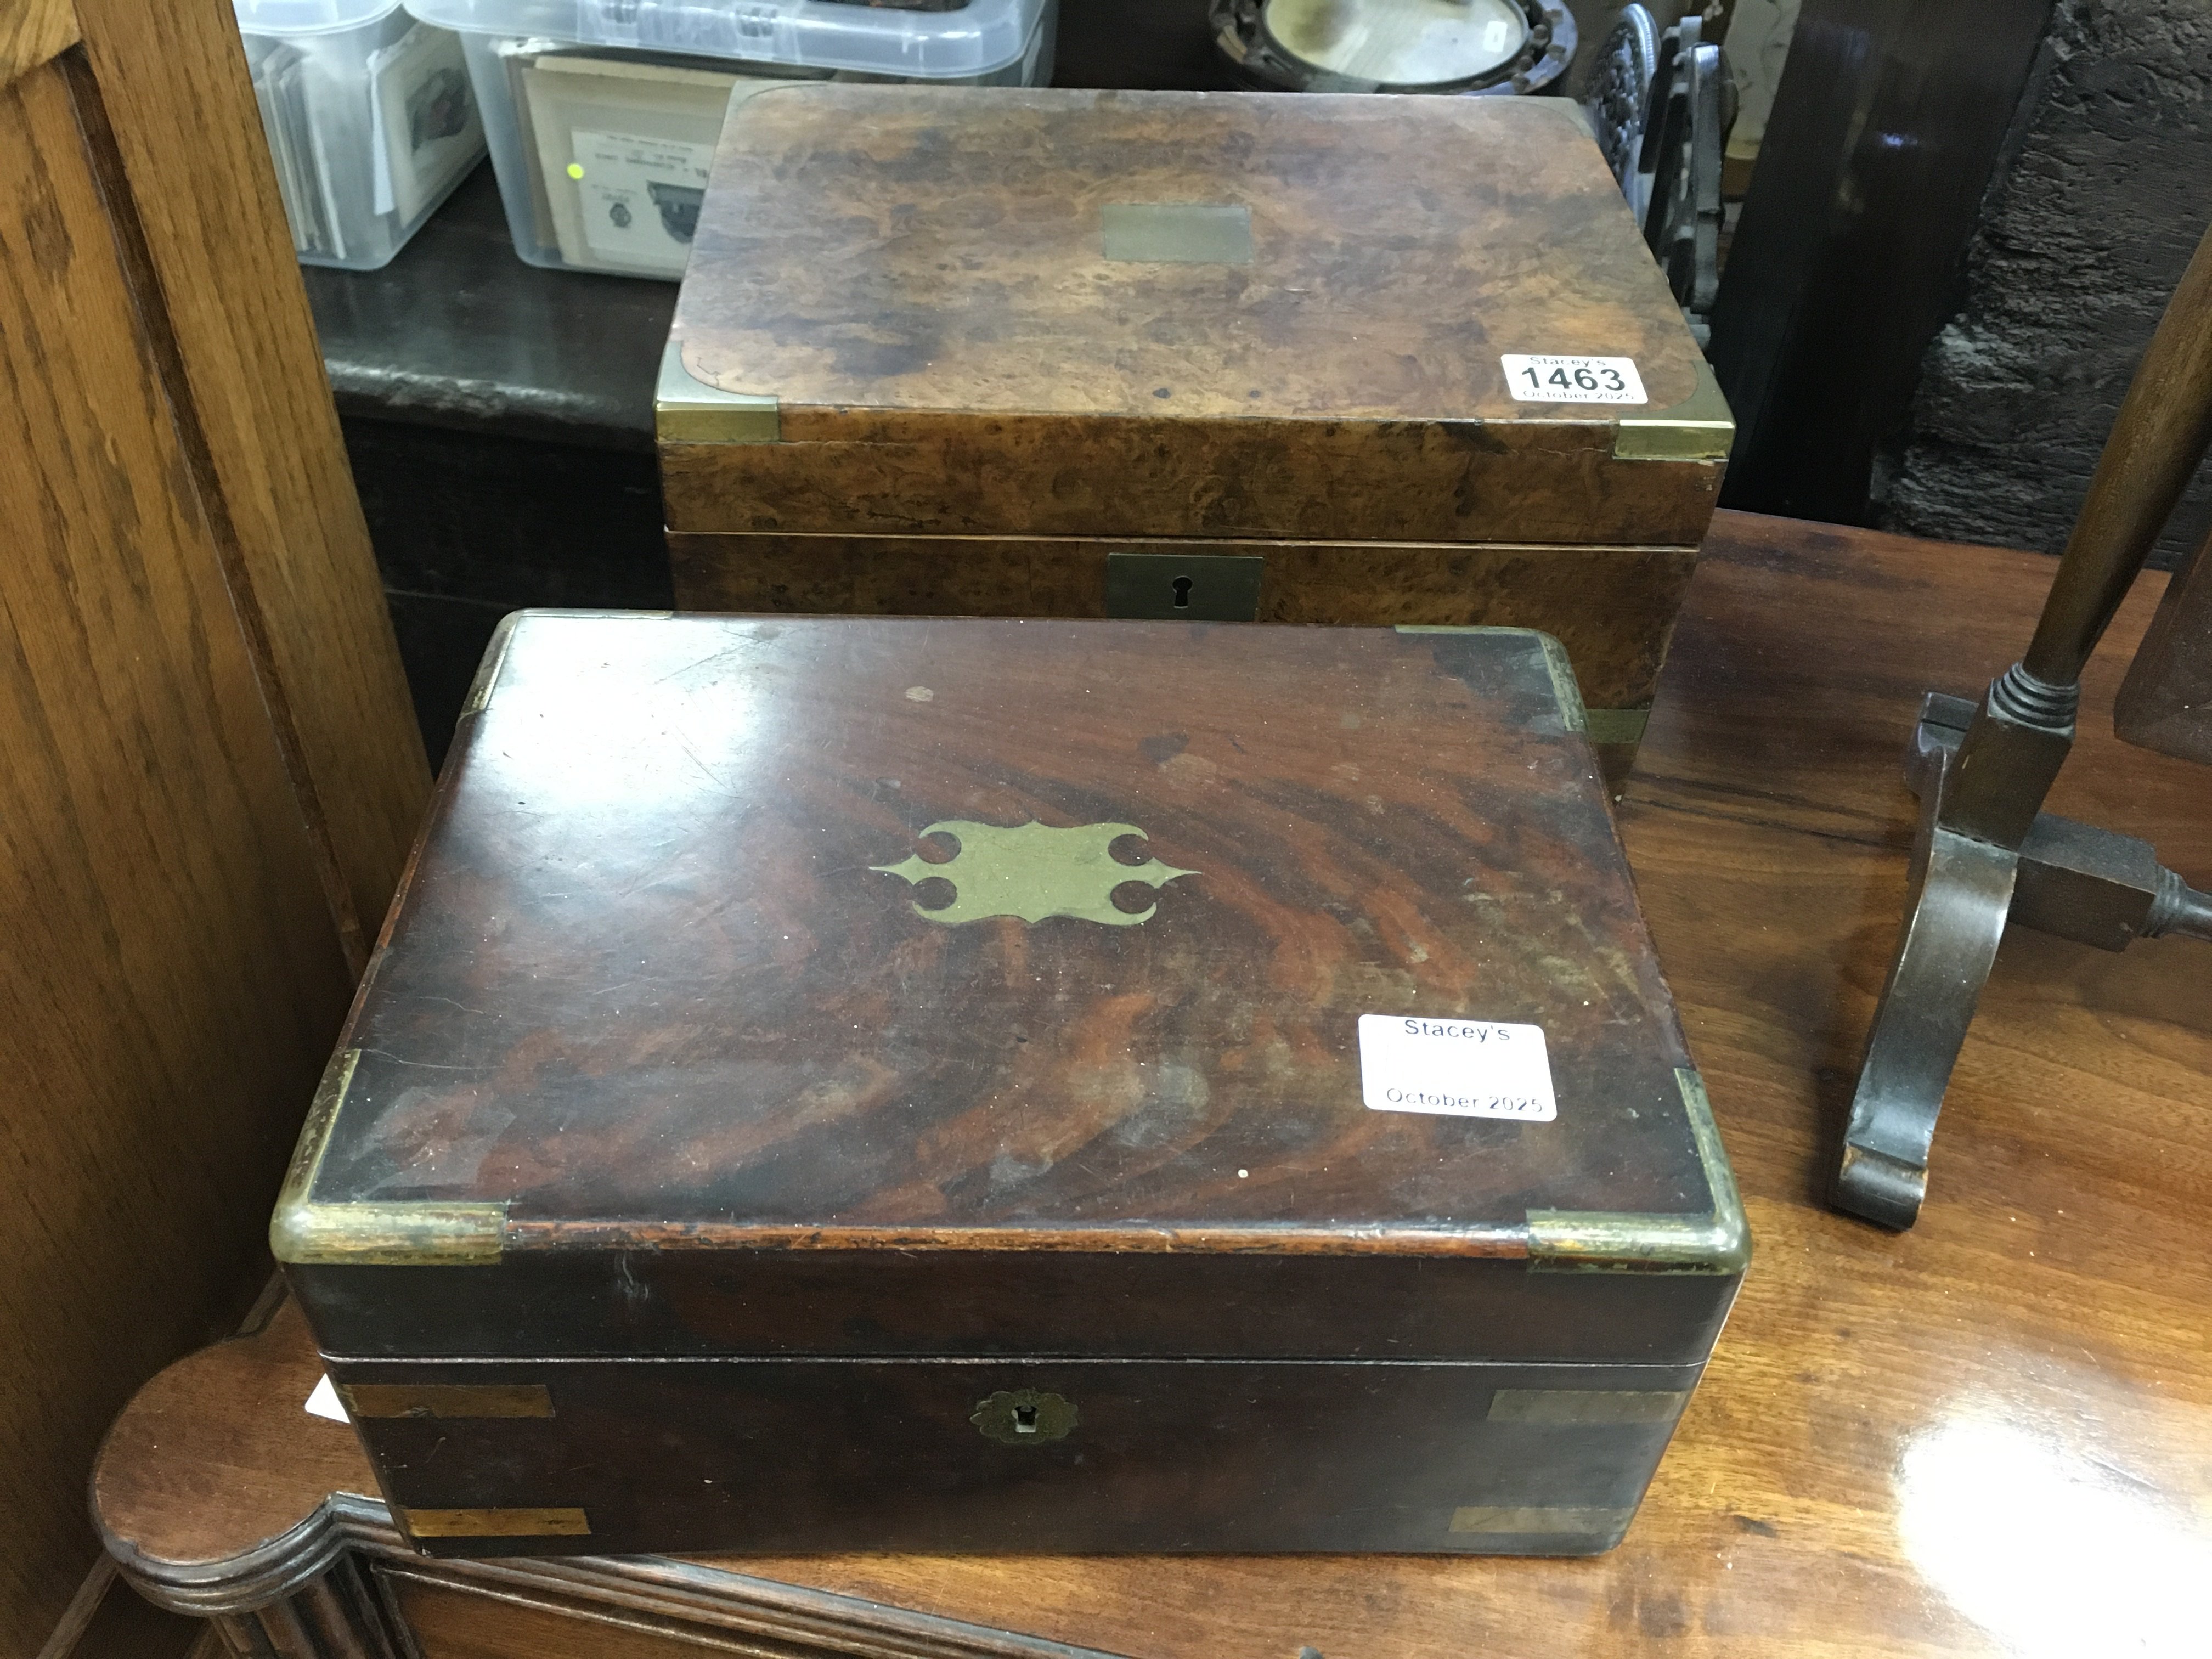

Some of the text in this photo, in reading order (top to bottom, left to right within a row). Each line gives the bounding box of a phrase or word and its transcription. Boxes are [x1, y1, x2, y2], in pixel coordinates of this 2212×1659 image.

[1530, 357, 1606, 367] Stacey's
[1521, 367, 1626, 391] 1463
[1523, 390, 1588, 399] October
[1404, 1019, 1510, 1043] Stacey's
[1386, 1088, 1543, 1113] October 2025
